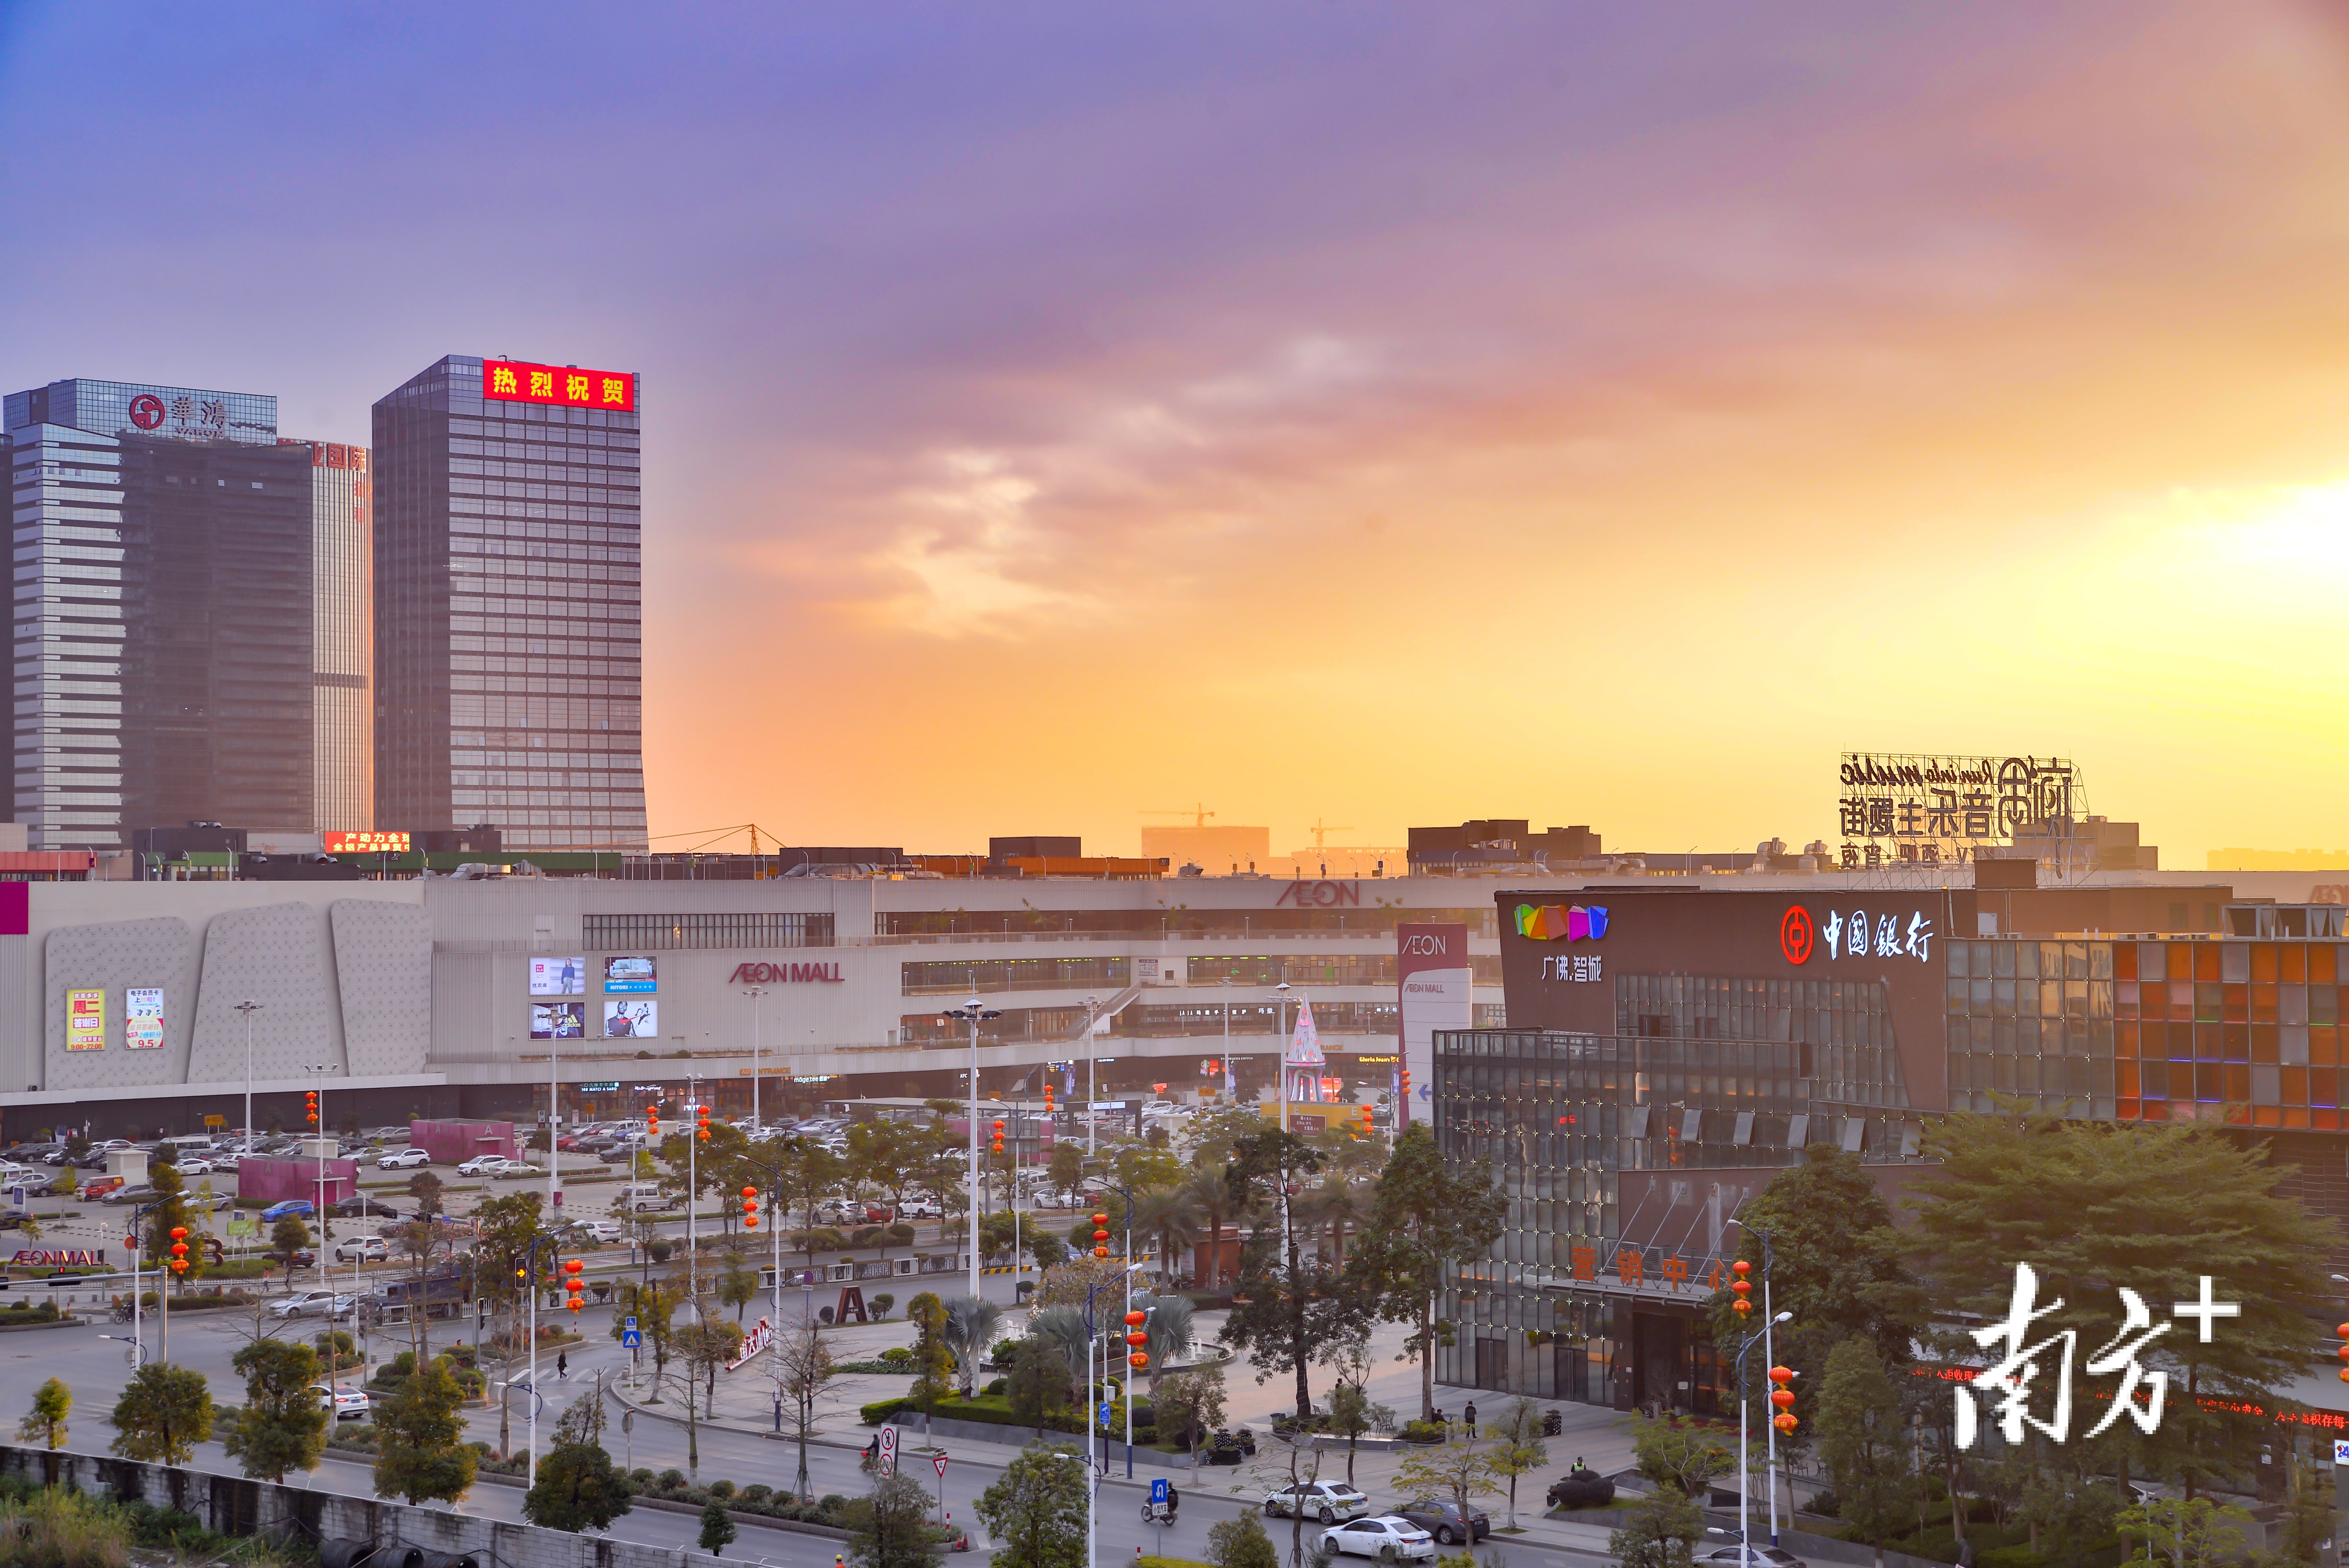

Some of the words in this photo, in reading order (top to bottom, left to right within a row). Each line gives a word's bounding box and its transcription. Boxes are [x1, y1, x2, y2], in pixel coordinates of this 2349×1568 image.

[494, 367, 624, 405] 热烈祝贺
[791, 963, 845, 982] MALL
[1425, 984, 1444, 993] MALL
[73, 1000, 100, 1014] 周二
[74, 1018, 98, 1028] 答谢日
[1294, 1105, 1299, 1114] E
[1351, 1107, 1357, 1116] E
[436, 1125, 441, 1134] A
[485, 1125, 493, 1135] A
[265, 1162, 272, 1174] A
[323, 1163, 333, 1175] A
[1571, 1245, 1734, 1293] 营销中心
[835, 1285, 868, 1325] A
[1774, 1419, 1787, 1428] 自由
[1153, 1504, 1167, 1514] 小型汽车
